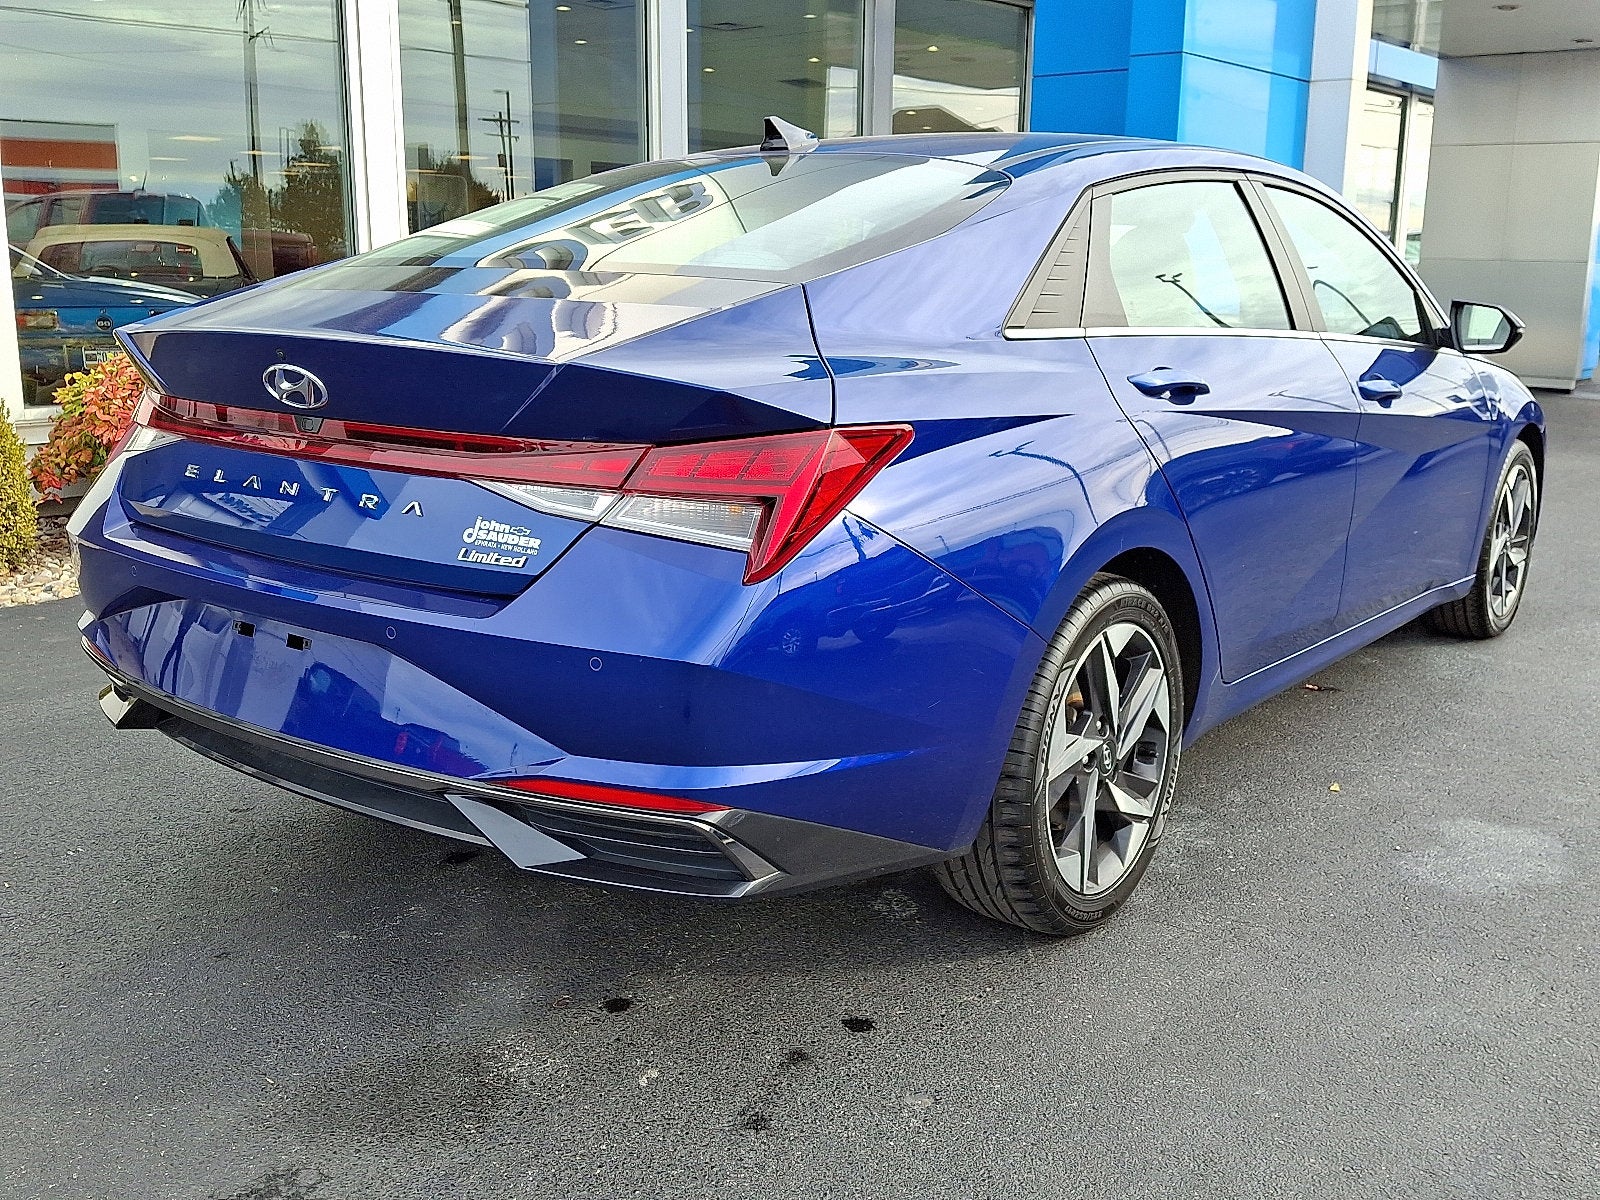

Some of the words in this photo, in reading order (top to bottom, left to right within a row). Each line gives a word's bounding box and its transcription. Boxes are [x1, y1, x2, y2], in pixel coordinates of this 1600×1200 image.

[184, 463, 424, 517] ELANTRA
[476, 529, 541, 550] SAUDER
[457, 547, 529, 568] Limited
